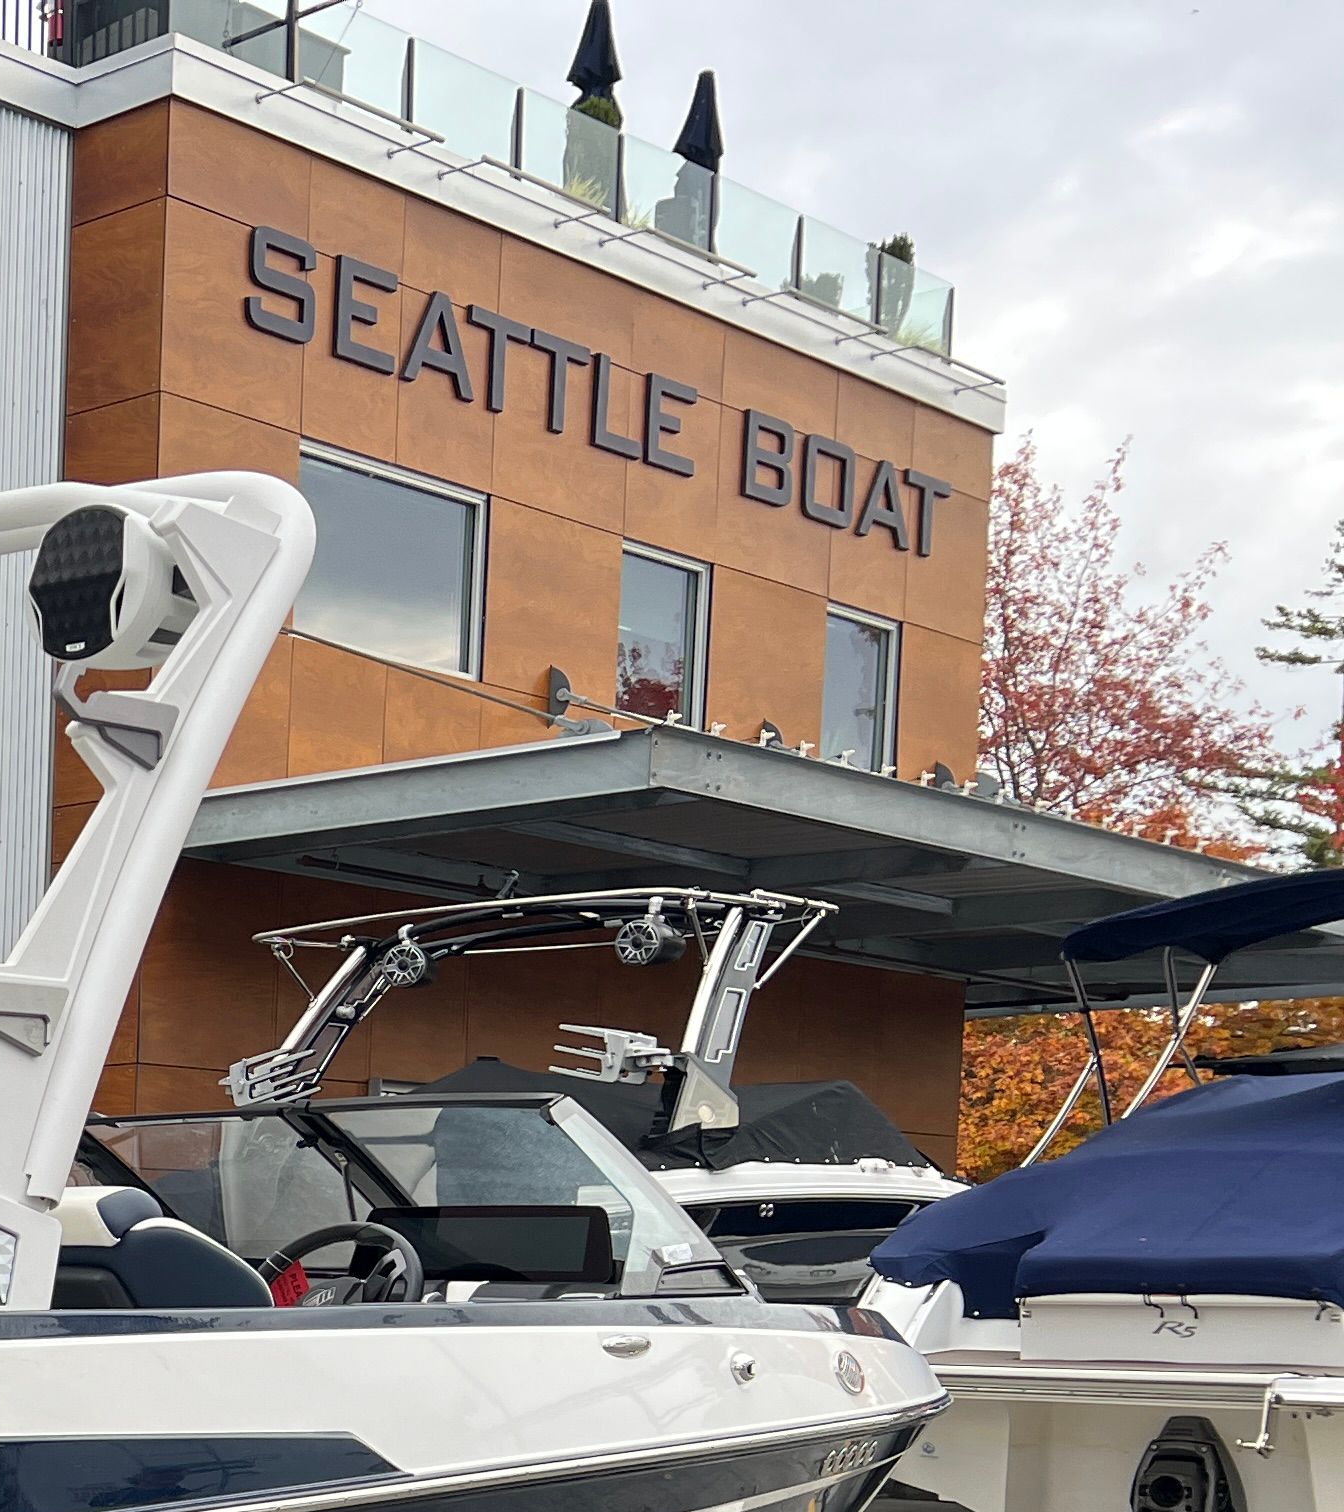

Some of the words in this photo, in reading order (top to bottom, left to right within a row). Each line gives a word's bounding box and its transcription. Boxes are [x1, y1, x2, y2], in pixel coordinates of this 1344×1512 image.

[244, 225, 698, 478] SEATTLE
[740, 408, 951, 558] BOAT
[1152, 1320, 1198, 1339] R5
